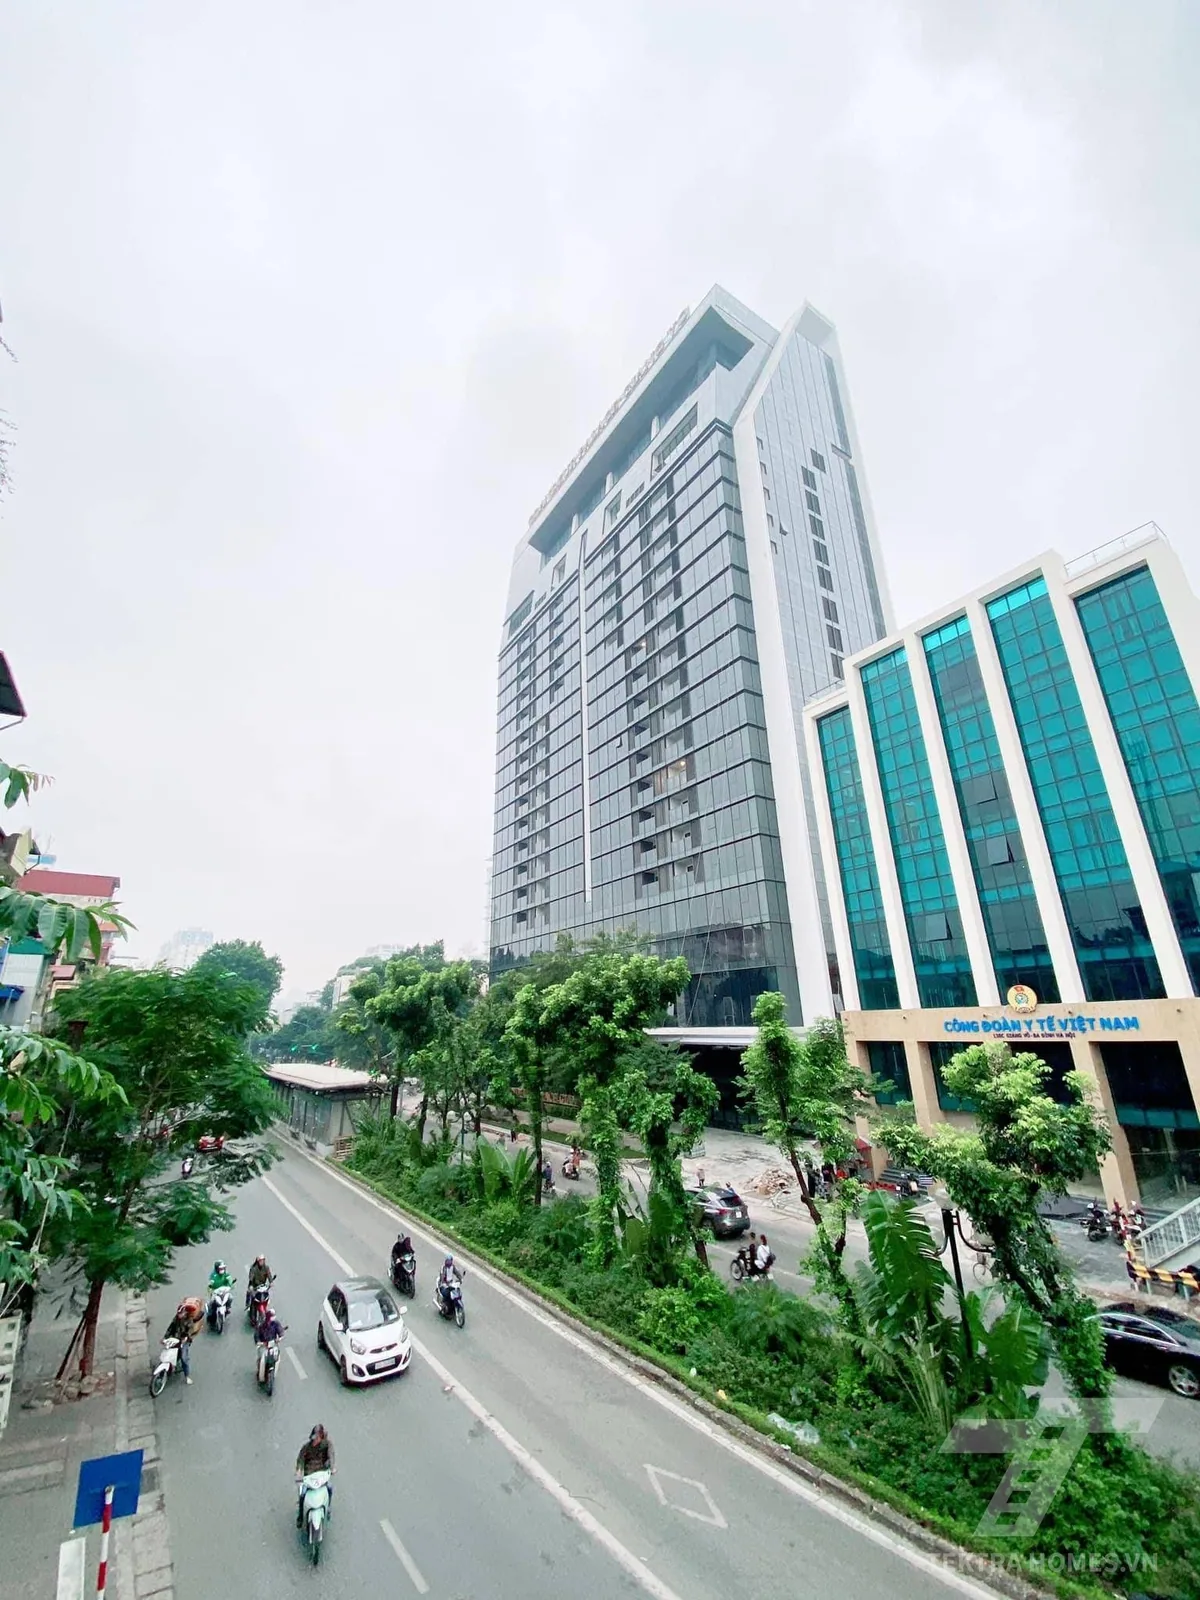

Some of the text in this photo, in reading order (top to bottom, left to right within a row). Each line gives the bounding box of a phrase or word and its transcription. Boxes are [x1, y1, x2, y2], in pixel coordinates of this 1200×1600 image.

[944, 1016, 1139, 1033] CÔNG ĐOÀN Y TẾ VIỆT NAM
